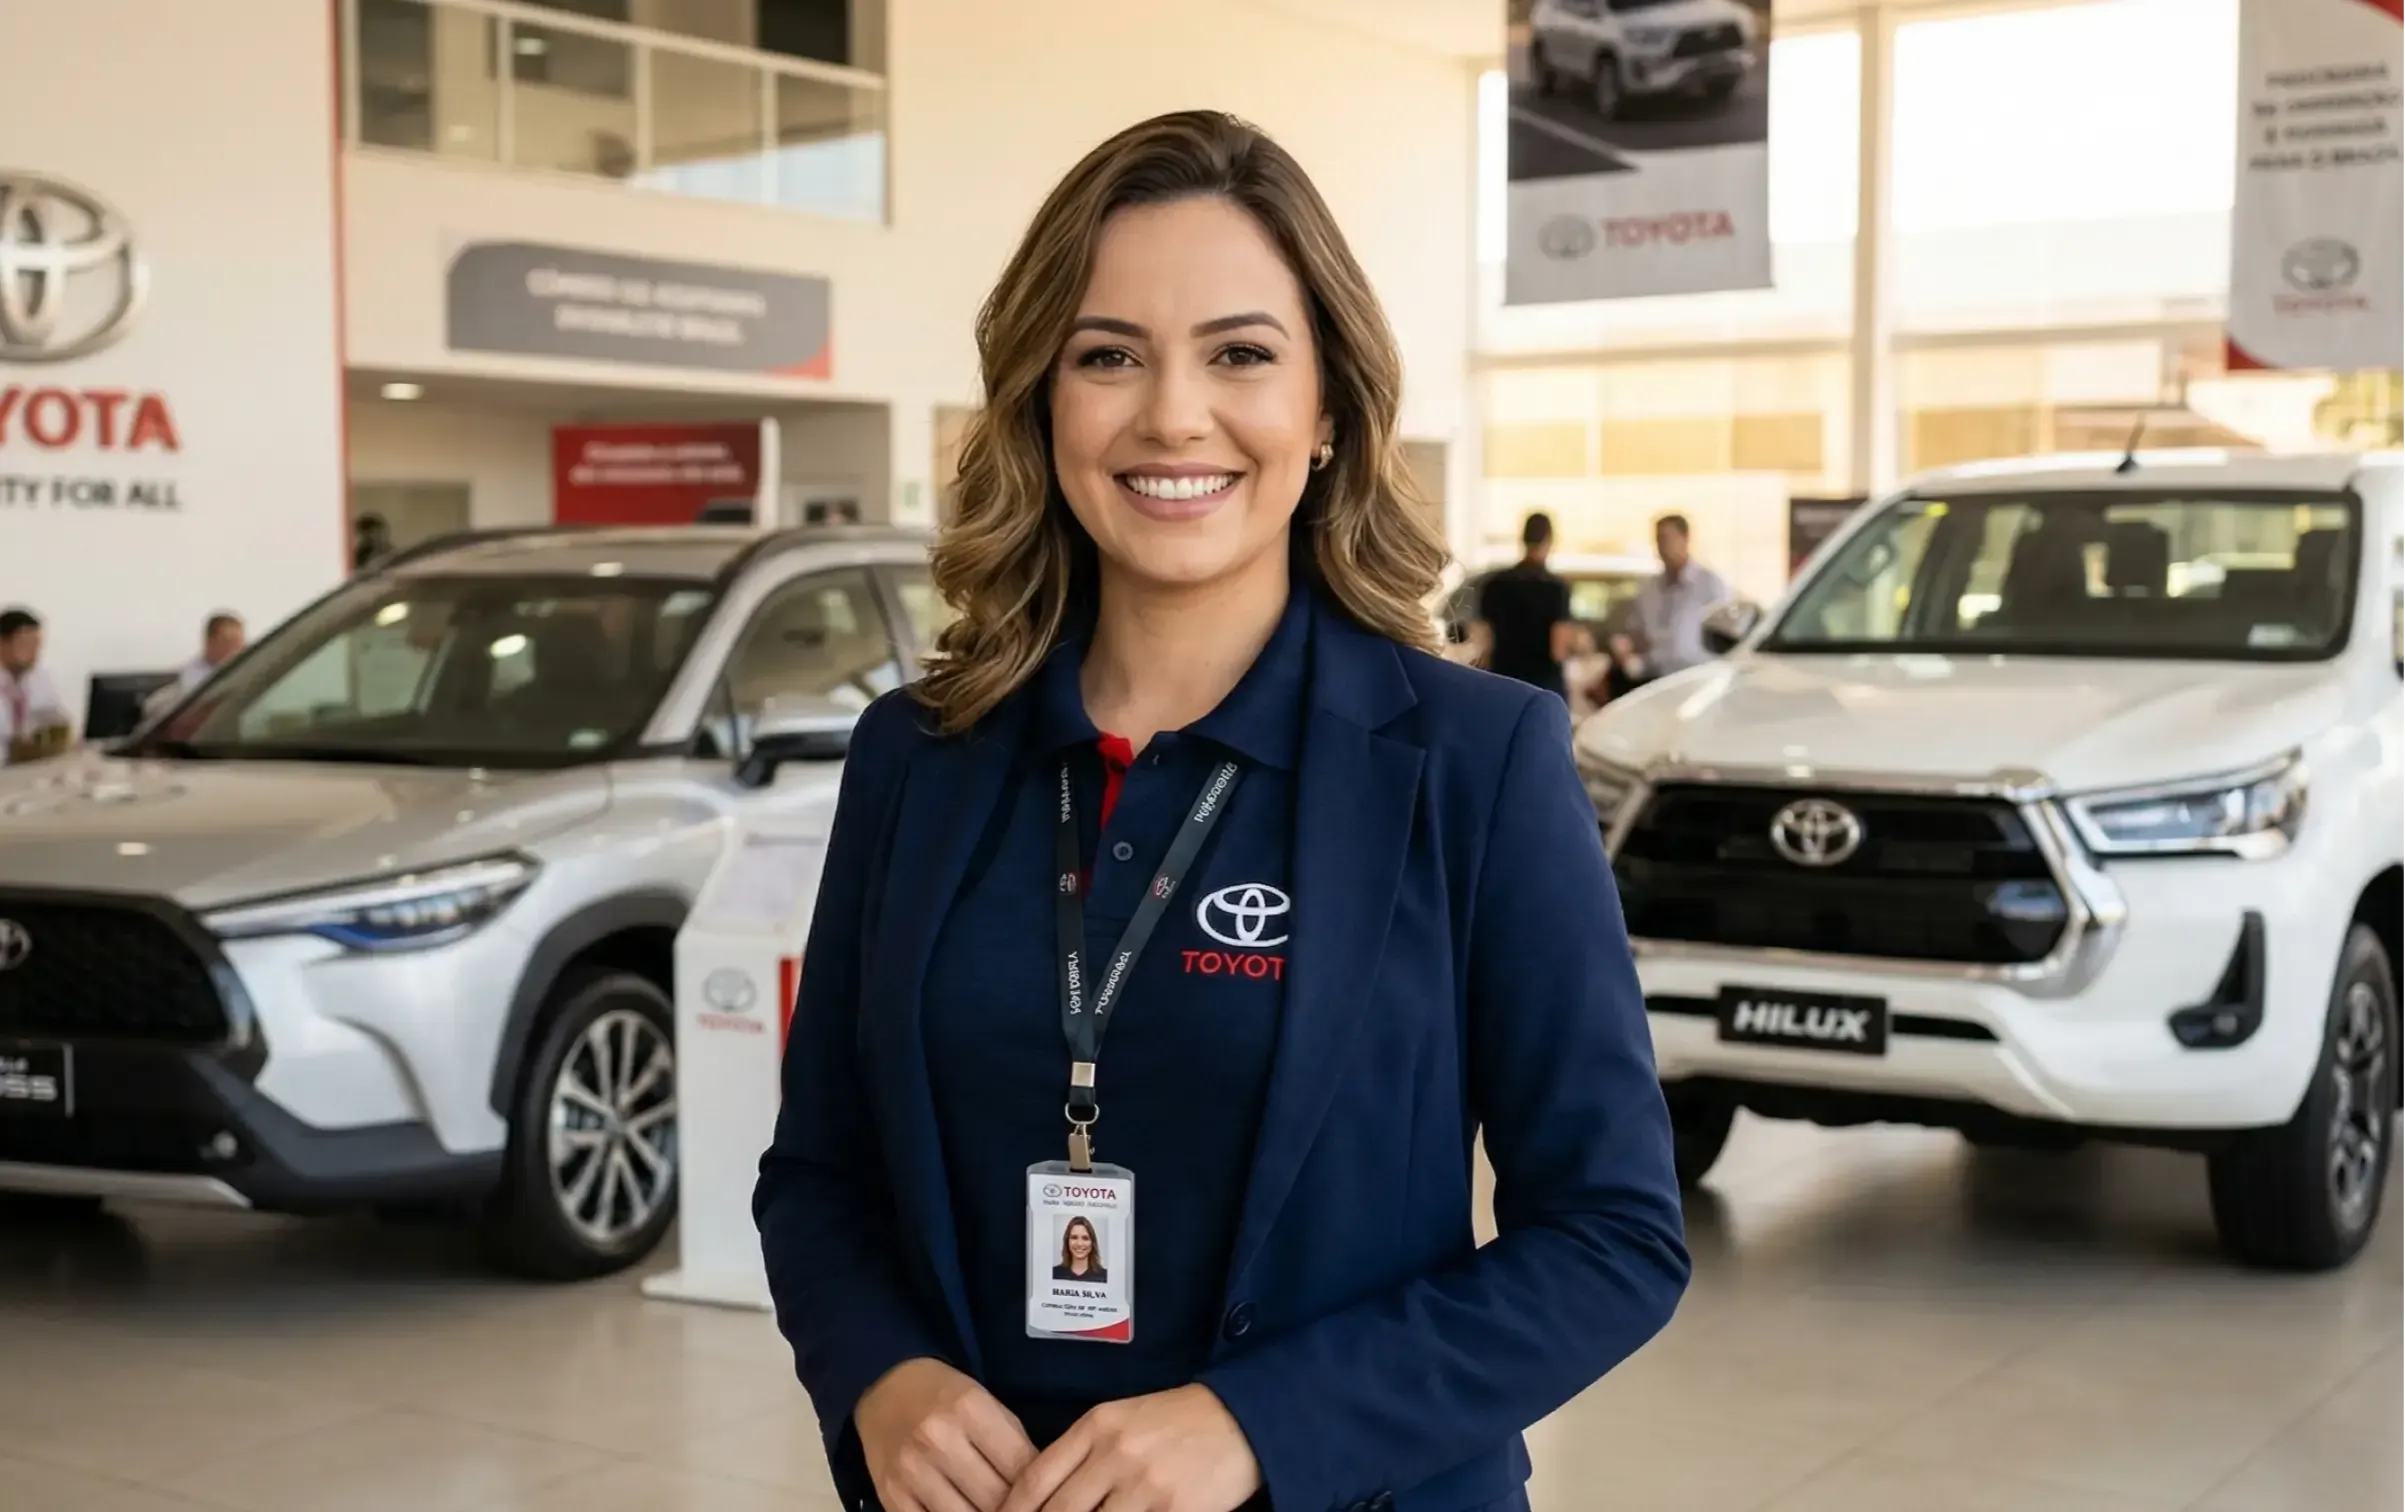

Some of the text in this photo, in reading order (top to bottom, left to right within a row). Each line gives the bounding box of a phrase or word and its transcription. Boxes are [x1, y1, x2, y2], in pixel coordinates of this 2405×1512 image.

[1181, 950, 1285, 981] TOYOT
[1733, 1000, 1872, 1042] HILUX
[0, 1073, 58, 1101] SS
[1063, 1186, 1117, 1200] TOYOTA
